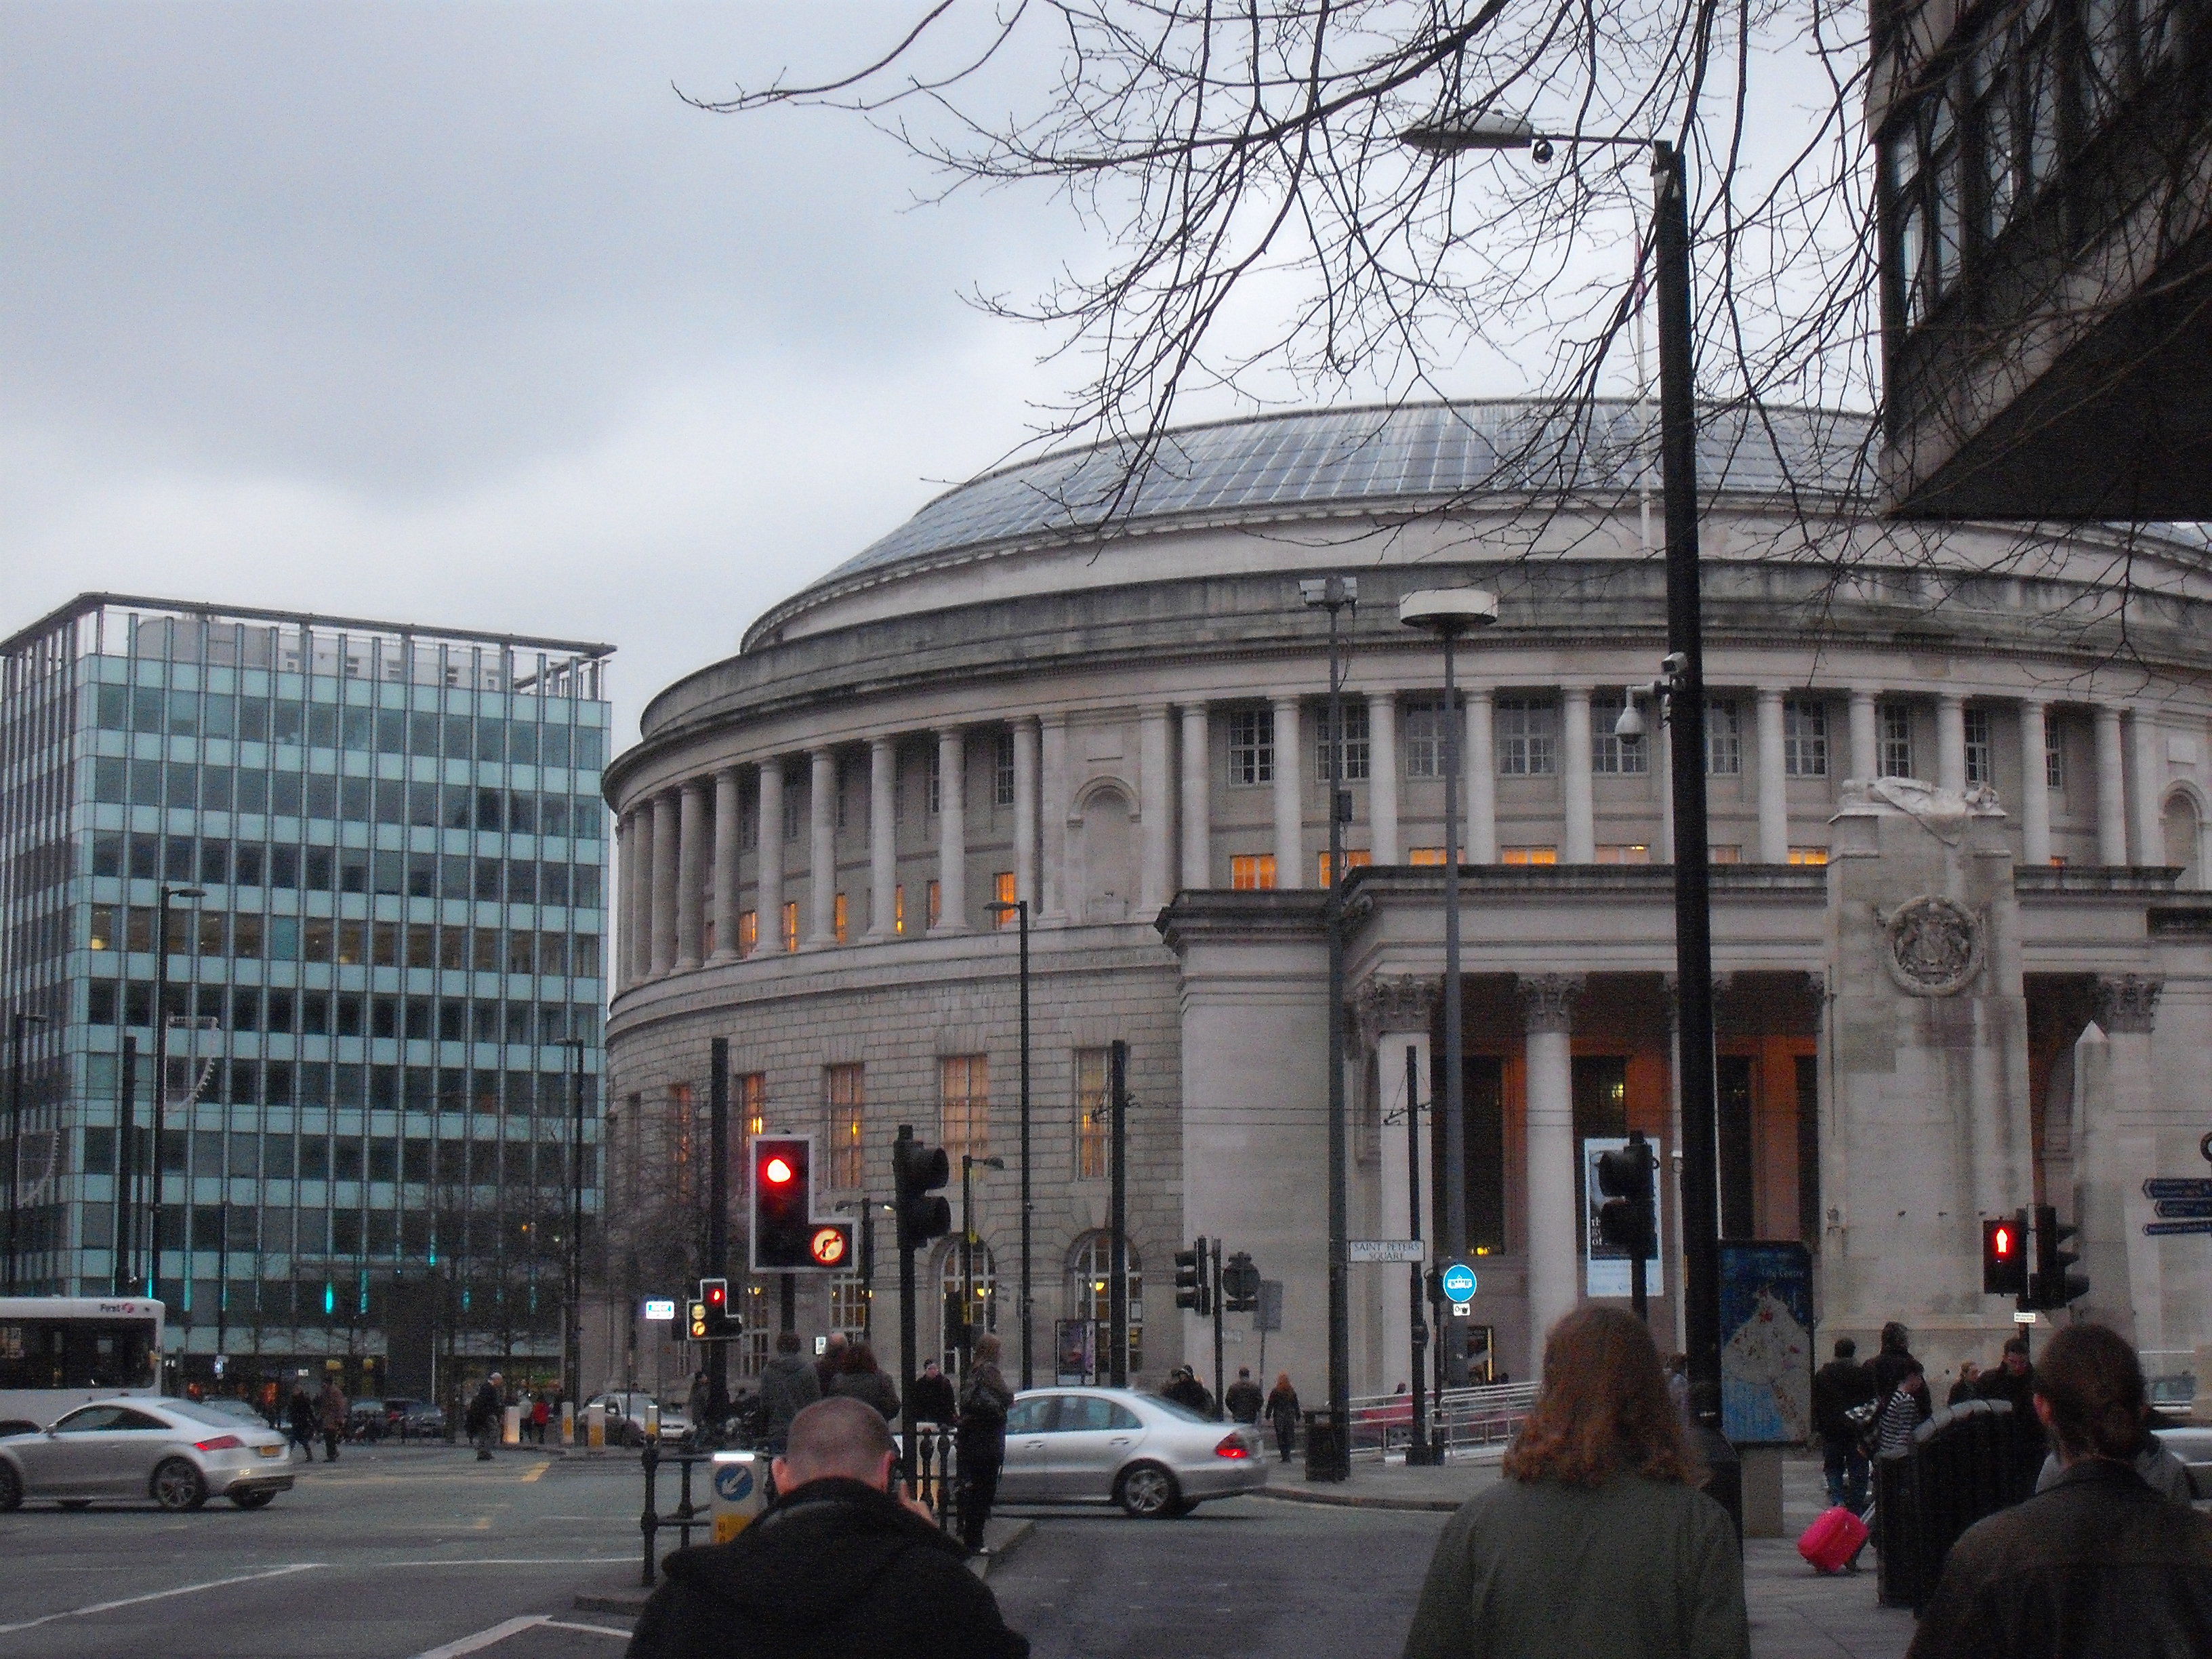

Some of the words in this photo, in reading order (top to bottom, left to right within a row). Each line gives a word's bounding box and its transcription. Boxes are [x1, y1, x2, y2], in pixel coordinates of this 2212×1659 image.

[1355, 1243, 1380, 1251] SAINT
[1387, 1242, 1420, 1251] PETERS
[1369, 1252, 1404, 1261] SQUARE
